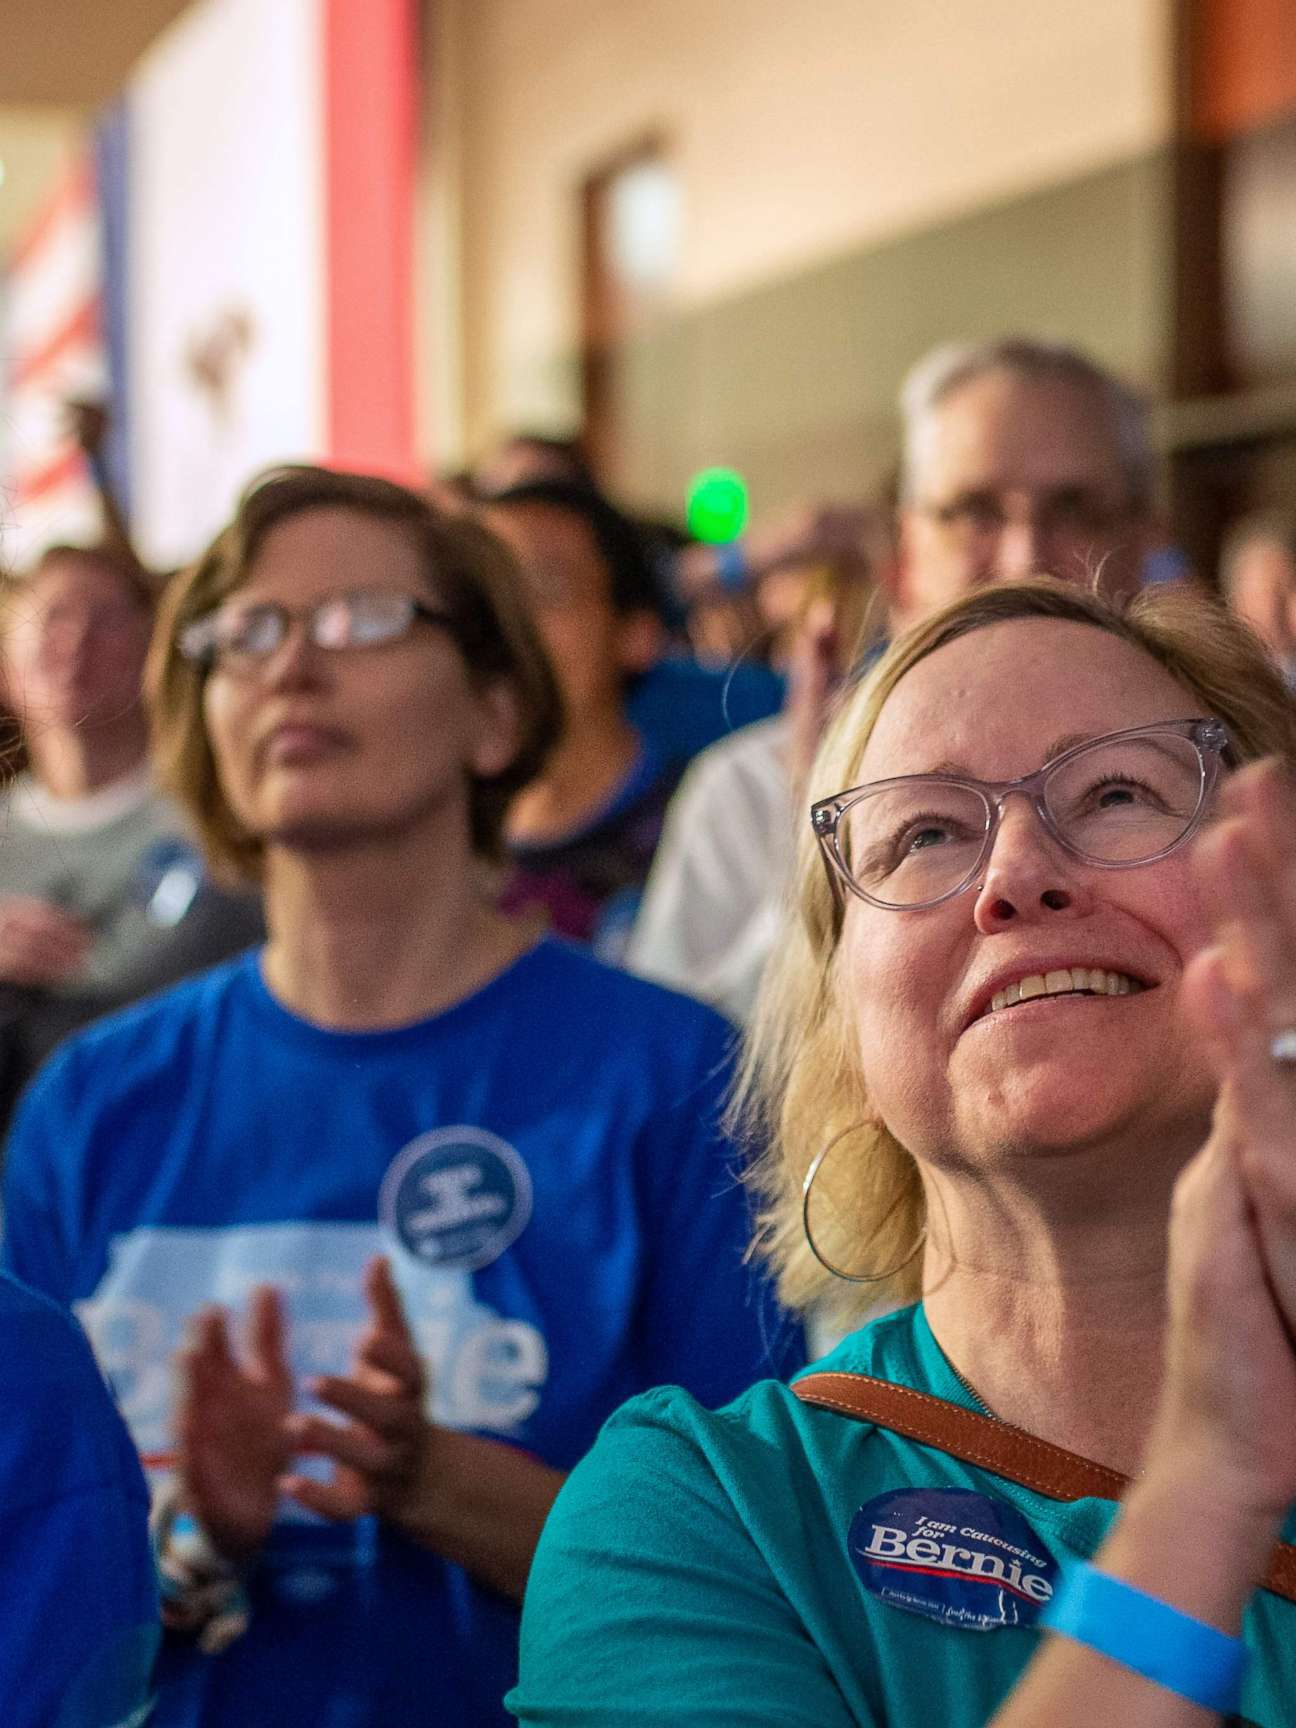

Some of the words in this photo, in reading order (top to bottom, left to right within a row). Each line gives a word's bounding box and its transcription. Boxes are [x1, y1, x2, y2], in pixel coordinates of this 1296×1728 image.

[912, 1526, 945, 1539] for
[915, 1516, 928, 1526] I
[927, 1520, 956, 1533] am
[960, 1527, 1047, 1568] Caucusing
[865, 1525, 1053, 1600] Bernie
